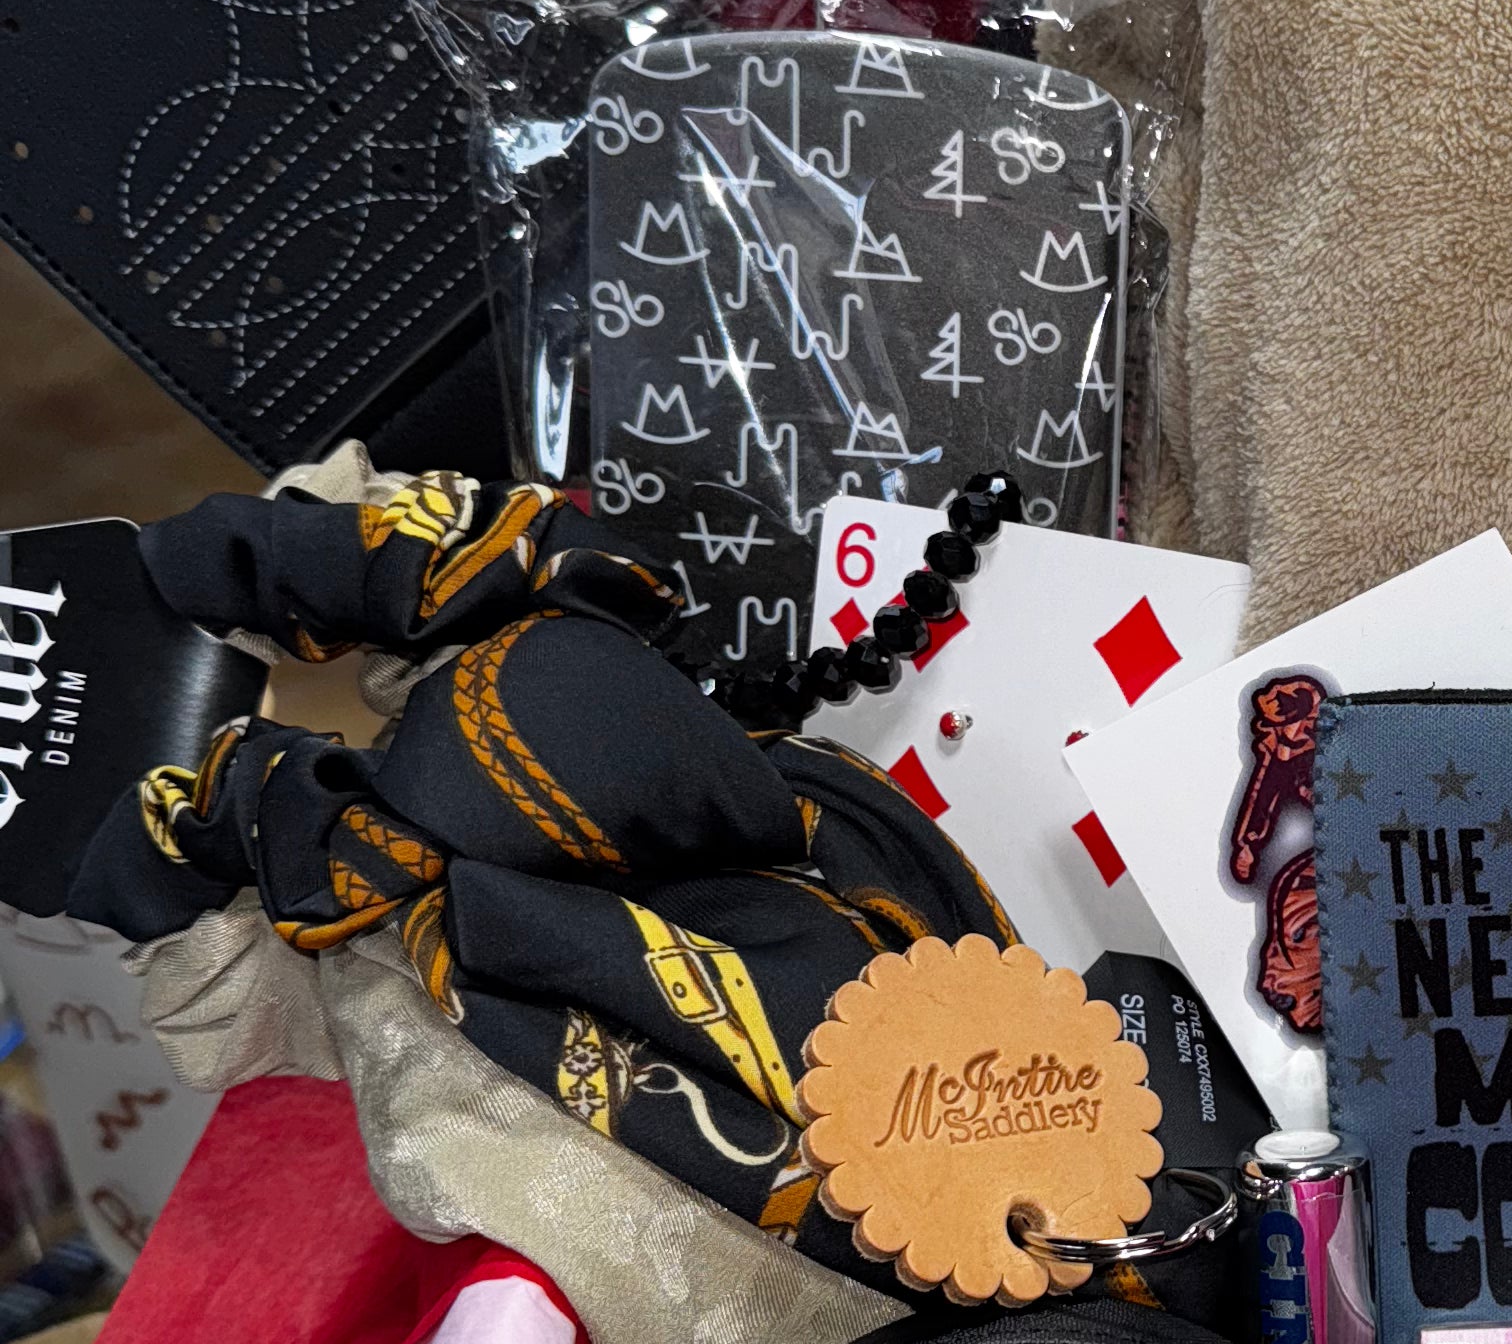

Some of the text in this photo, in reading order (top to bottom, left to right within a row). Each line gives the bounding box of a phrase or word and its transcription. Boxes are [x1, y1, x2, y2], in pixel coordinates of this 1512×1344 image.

[836, 521, 877, 588] 6
[40, 670, 88, 766] DENIM
[1379, 828, 1490, 907] THE
[1120, 993, 1147, 1045] SIZE
[1171, 994, 1193, 1064] PO 125074
[1186, 999, 1205, 1040] STYLE
[873, 1049, 1104, 1147] McIntire
[943, 1097, 1103, 1145] Saddlery
